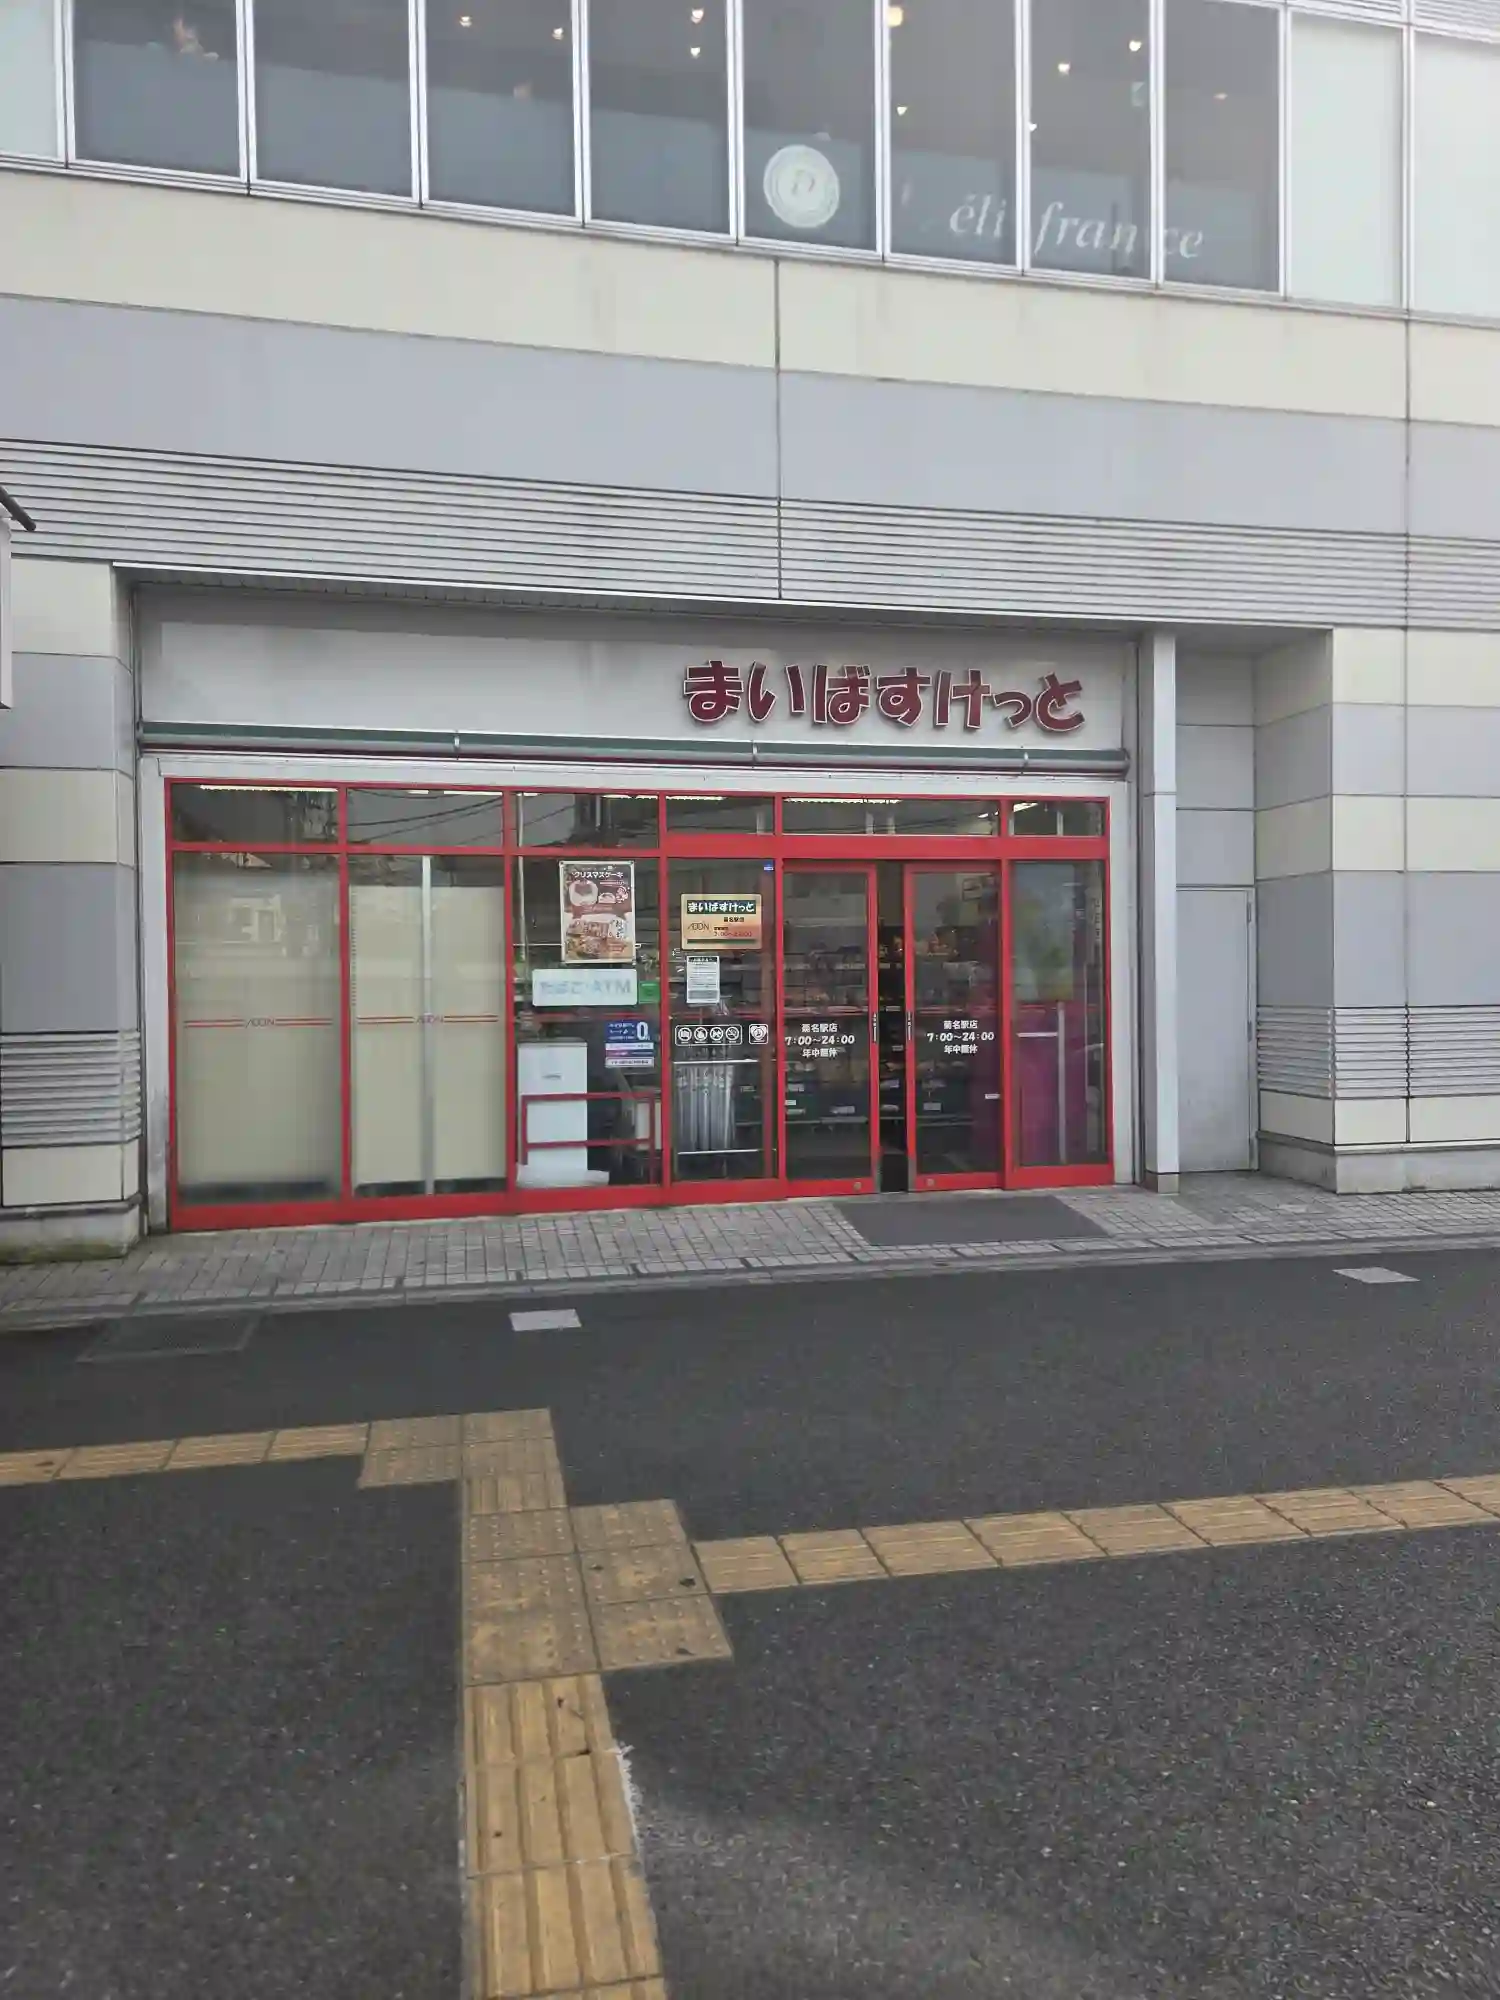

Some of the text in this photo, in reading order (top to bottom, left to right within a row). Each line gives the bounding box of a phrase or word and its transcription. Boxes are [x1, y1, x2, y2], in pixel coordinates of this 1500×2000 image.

[684, 660, 1085, 732] まいばすけっと
[687, 901, 755, 913] まいばすけっと
